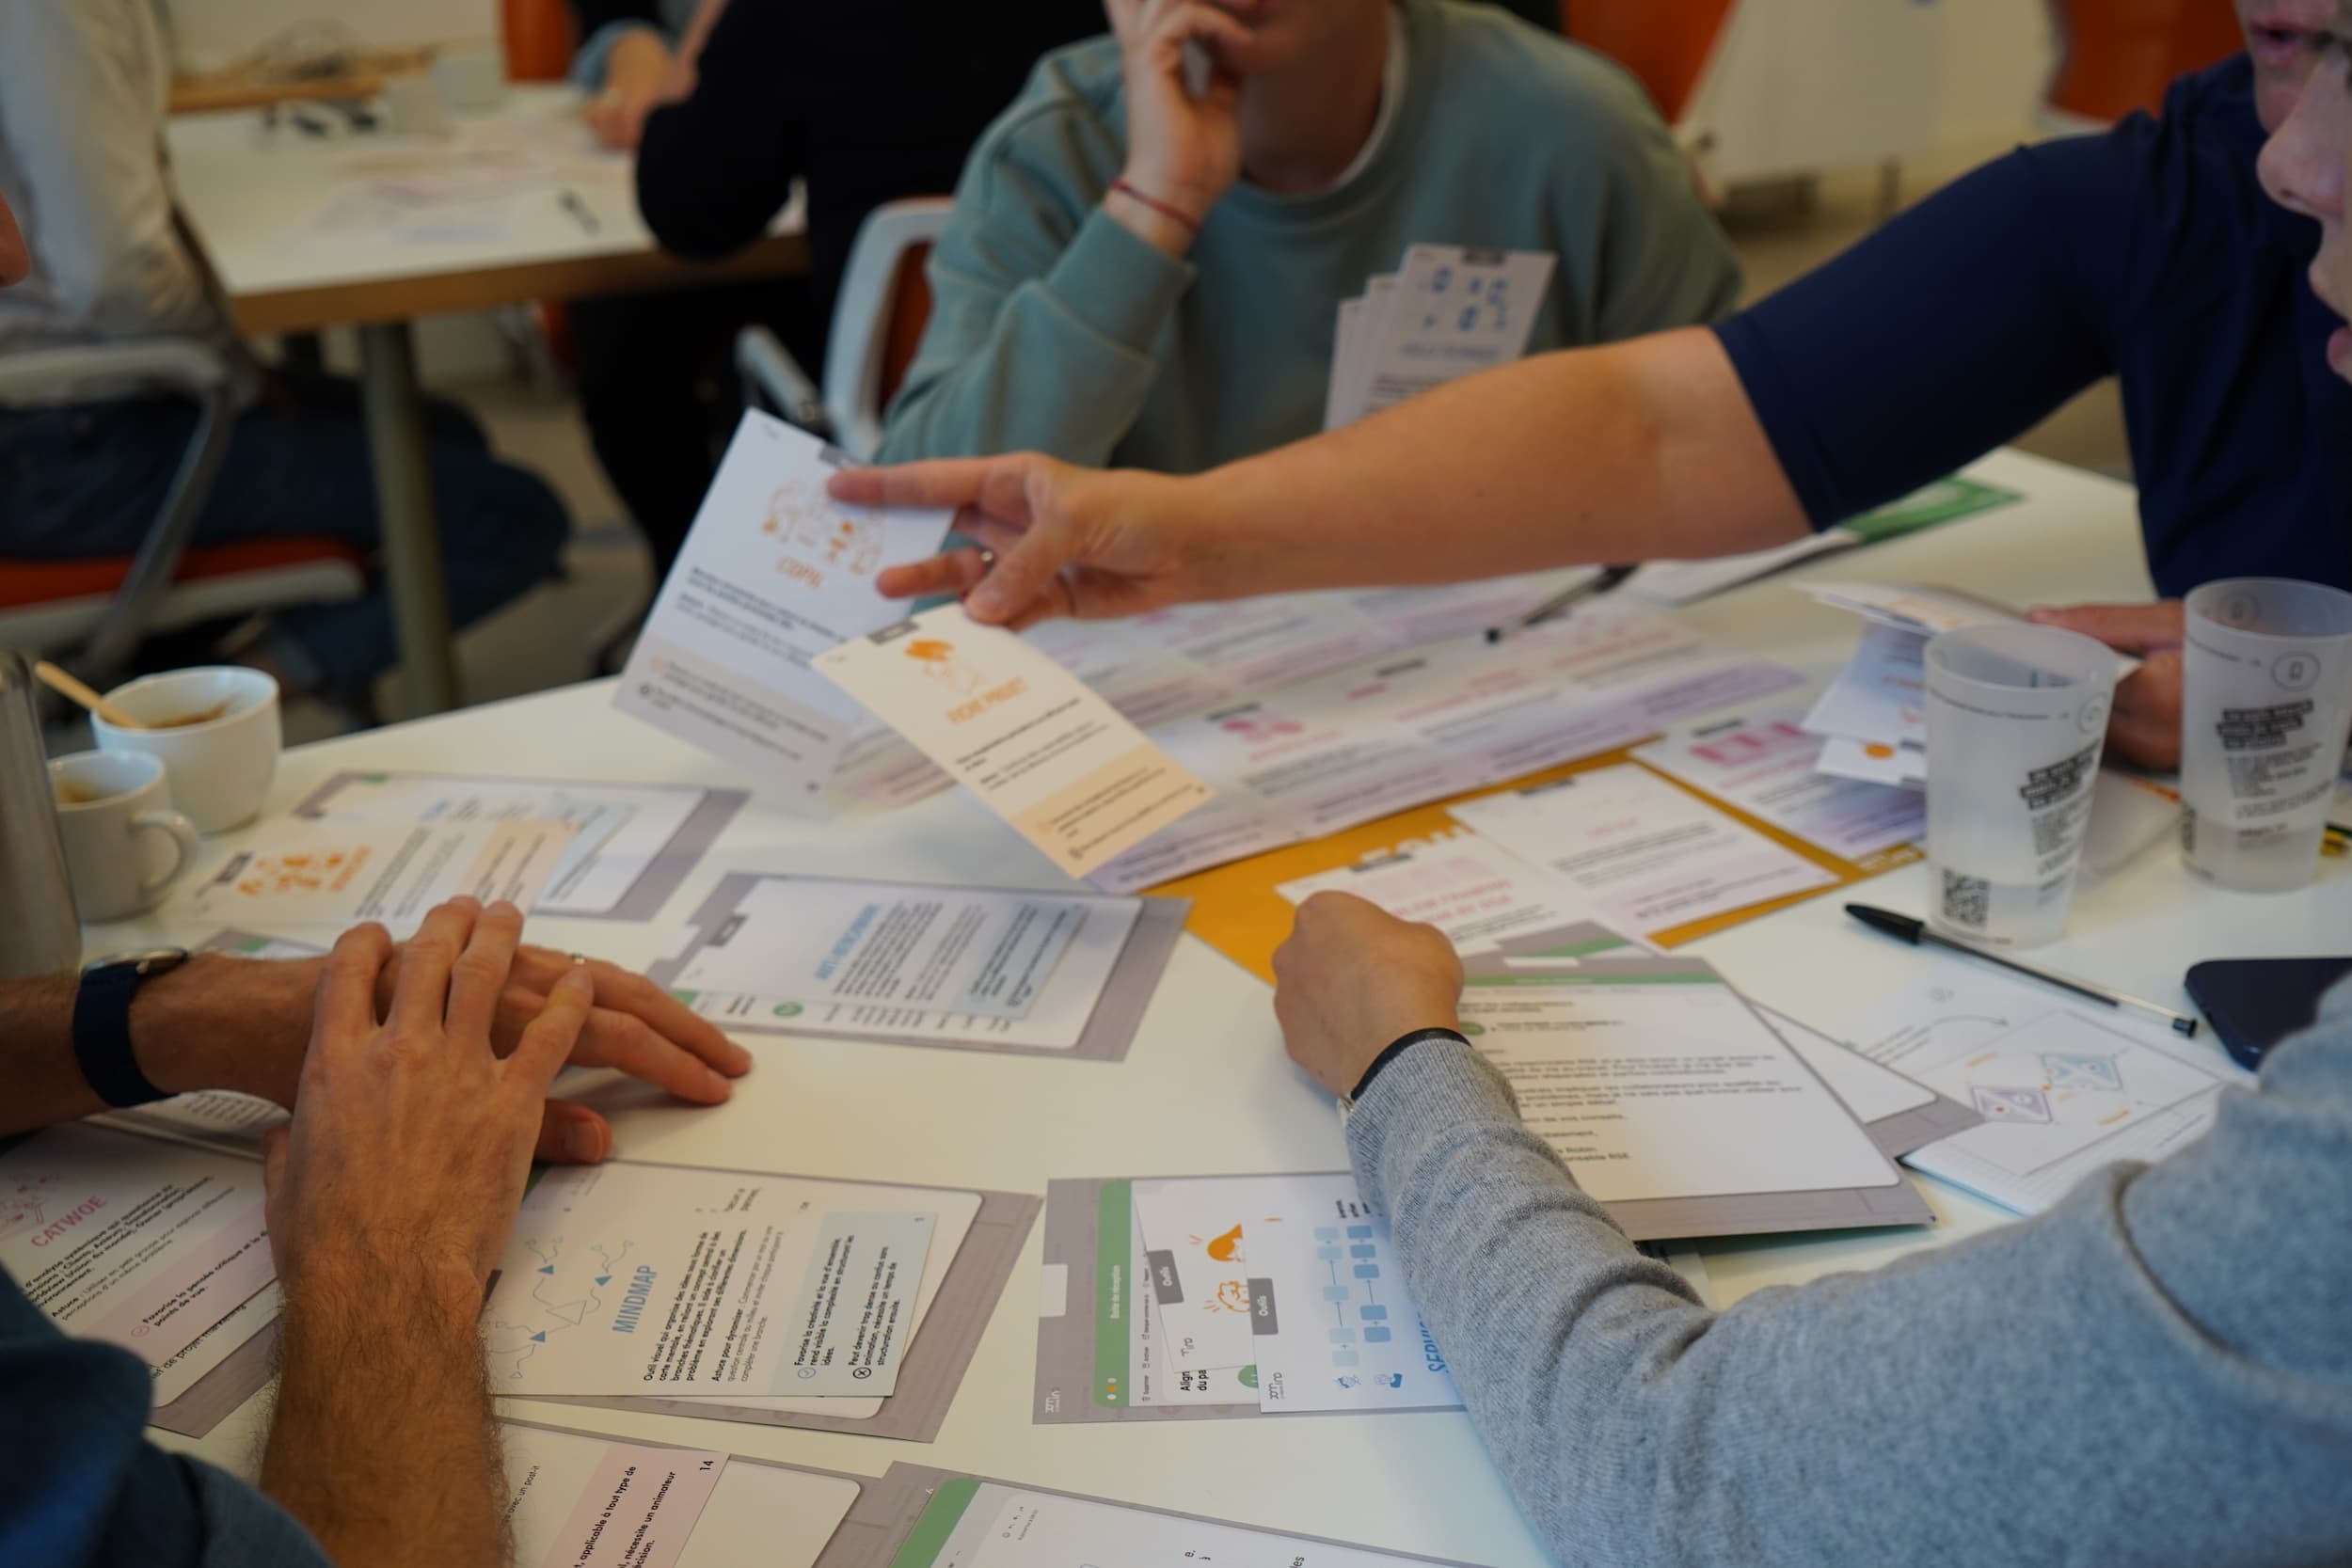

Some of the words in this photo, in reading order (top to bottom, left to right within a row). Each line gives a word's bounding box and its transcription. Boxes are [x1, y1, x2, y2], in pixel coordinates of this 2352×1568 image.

[31, 1196, 106, 1247] CATWOE
[611, 1264, 657, 1334] MINDMAP
[1257, 1295, 1268, 1316] Outils
[663, 1303, 684, 1329] organise
[814, 1328, 827, 1348] visible
[853, 1325, 867, 1349] devenir
[863, 1330, 882, 1365] animation,
[650, 1343, 666, 1362] visuel
[711, 1359, 727, 1381] Astuce
[722, 1342, 736, 1357] pour
[794, 1338, 810, 1365] Favorise
[809, 1350, 820, 1365] rend
[849, 1351, 861, 1365] Peut
[643, 1364, 658, 1380] Outil
[657, 1364, 672, 1380] carte
[671, 1350, 690, 1380] branches
[1180, 1370, 1193, 1391] Align
[1197, 1380, 1207, 1391] du
[524, 1465, 540, 1486] post-it
[626, 1465, 637, 1478] de
[700, 1461, 713, 1471] 14
[614, 1478, 630, 1496] type
[609, 1495, 620, 1512] tout
[625, 1524, 648, 1560] nécessite
[644, 1512, 654, 1523] un
[651, 1471, 675, 1512] animateur
[580, 1516, 607, 1561] applicable
